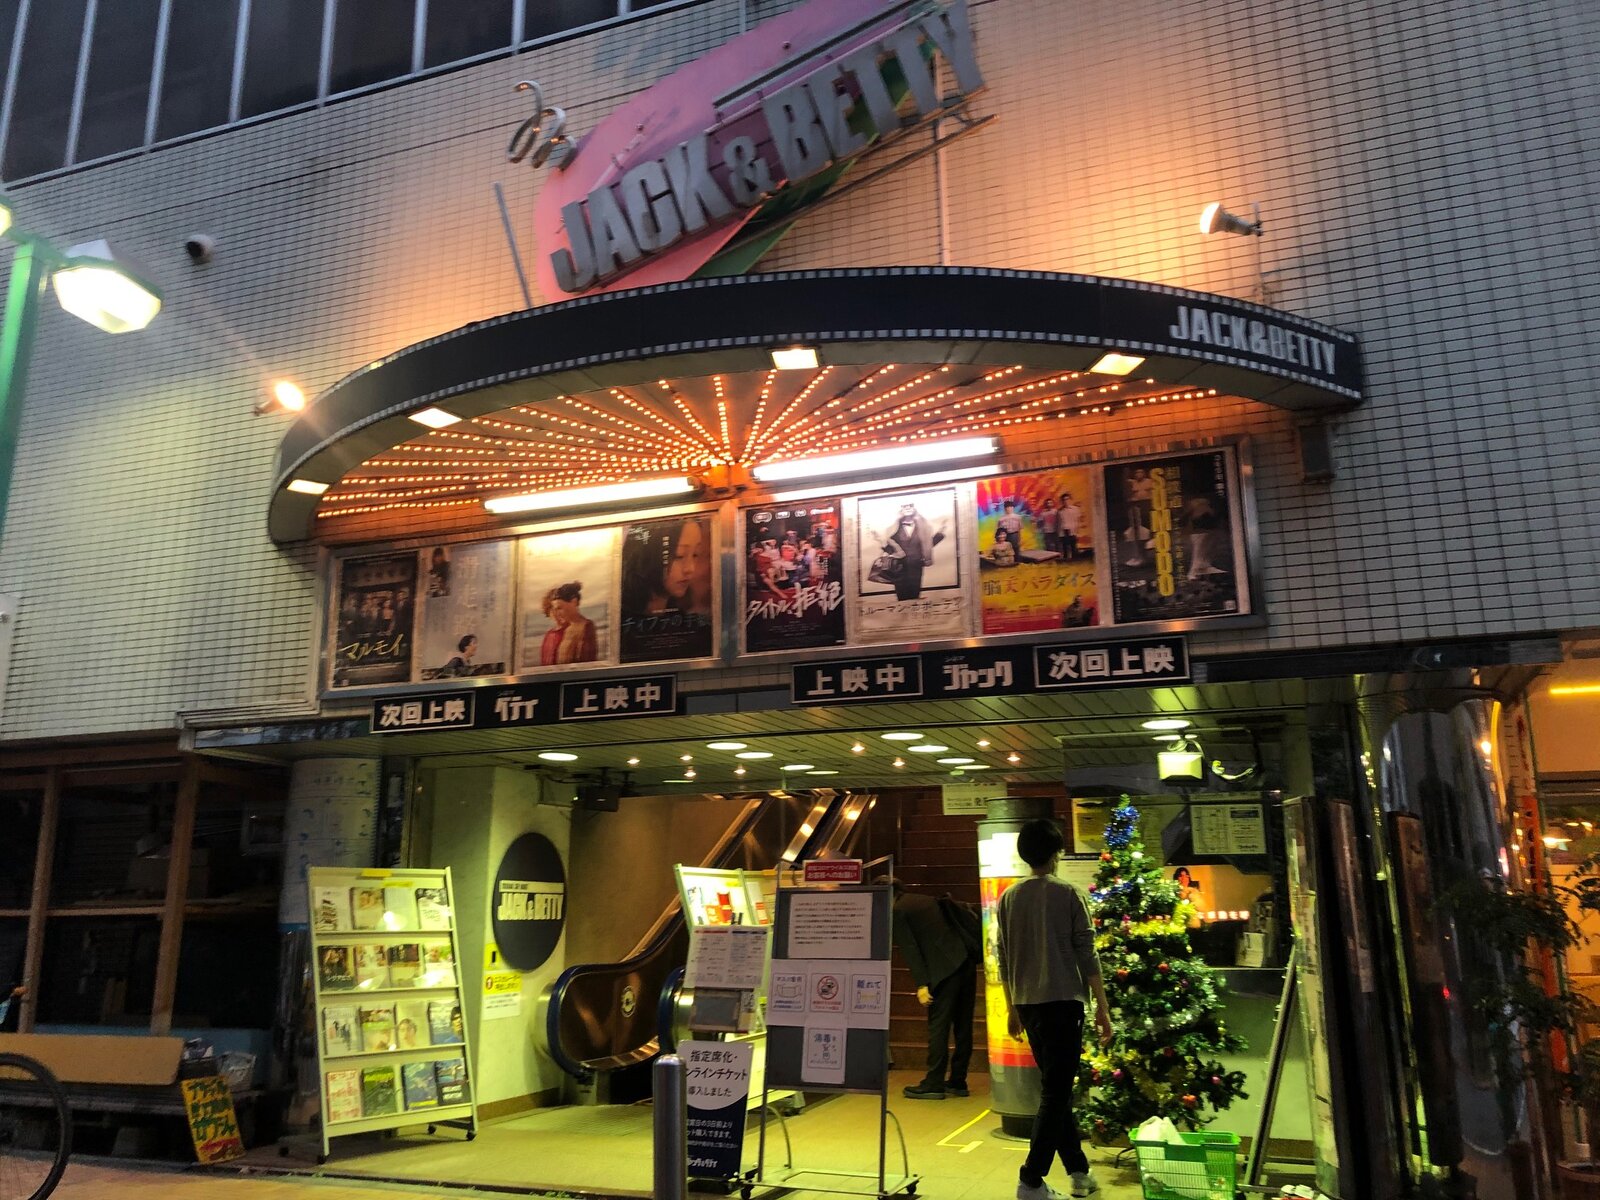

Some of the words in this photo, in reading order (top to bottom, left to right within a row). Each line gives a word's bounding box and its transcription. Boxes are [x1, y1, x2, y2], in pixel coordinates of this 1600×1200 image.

[1169, 305, 1336, 375] JACK&BETTY
[341, 633, 404, 662] マルモイ
[1050, 645, 1175, 680] 次回上映
[807, 663, 905, 696] 上映中
[379, 699, 466, 727] 次回上映
[574, 683, 661, 713] 上映中
